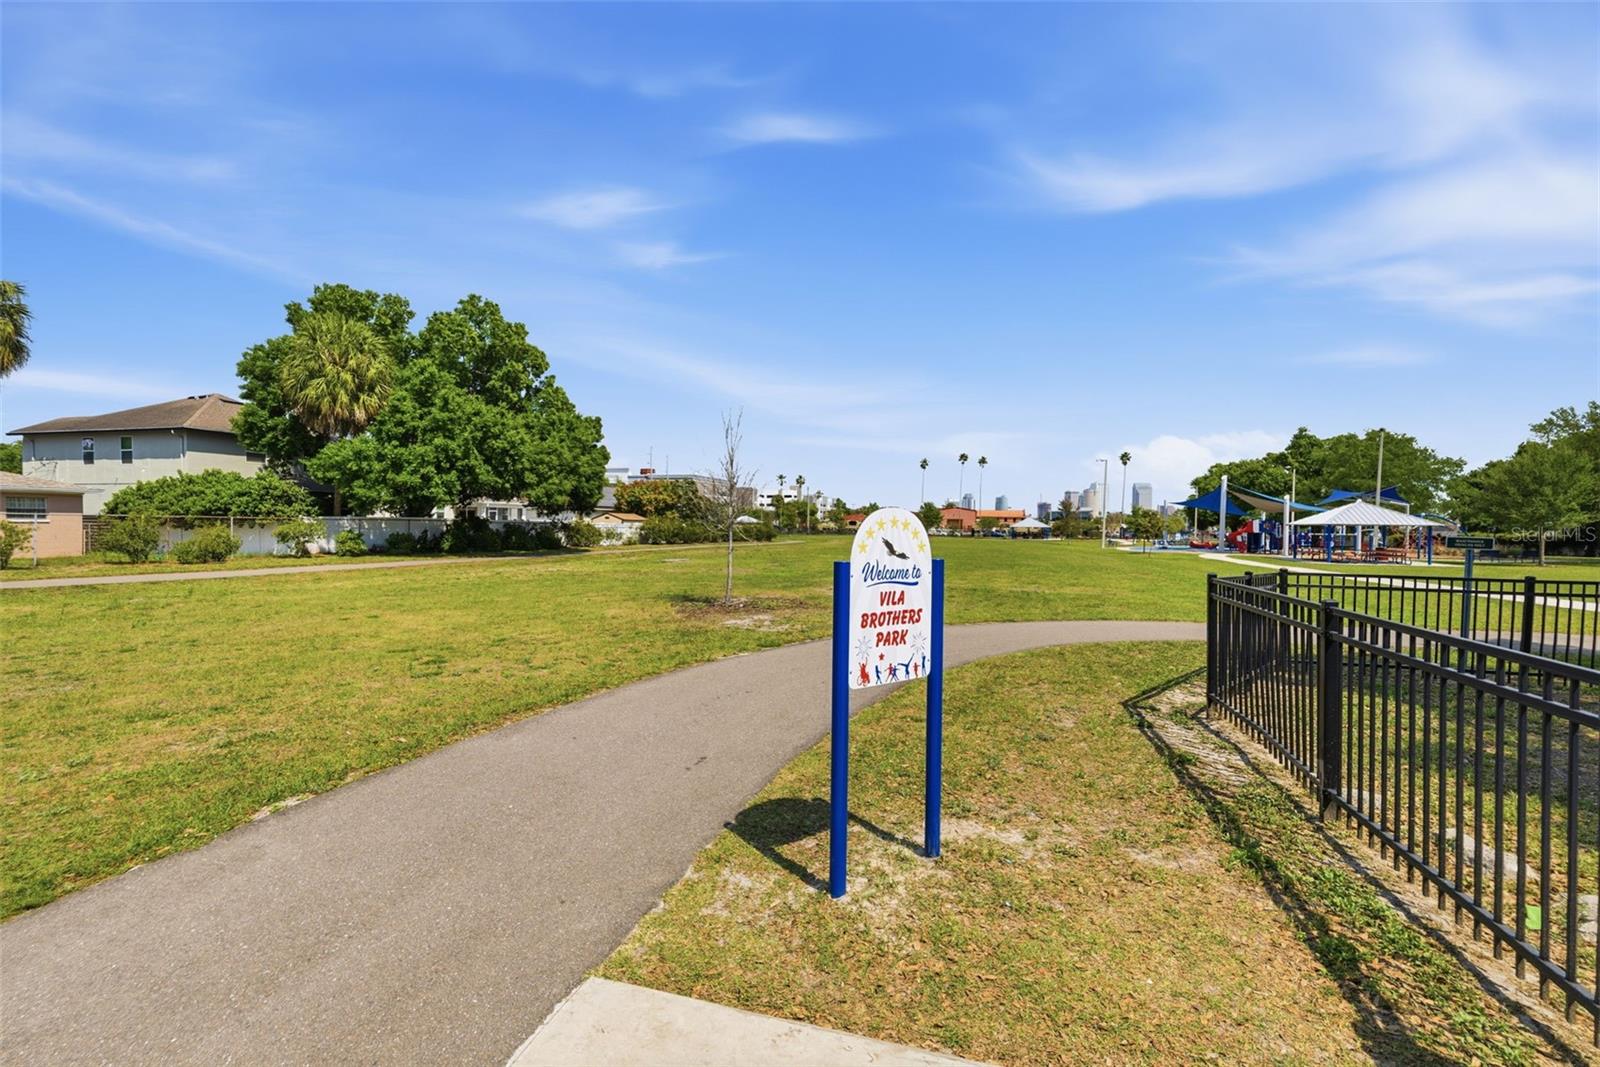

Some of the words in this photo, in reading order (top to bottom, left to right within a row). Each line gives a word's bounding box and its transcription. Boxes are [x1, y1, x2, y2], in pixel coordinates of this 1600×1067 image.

[862, 559, 910, 583] Welcome
[911, 564, 922, 580] to
[879, 590, 905, 606] VILA
[860, 608, 923, 629] BROTHERS
[875, 629, 909, 648] PARK
